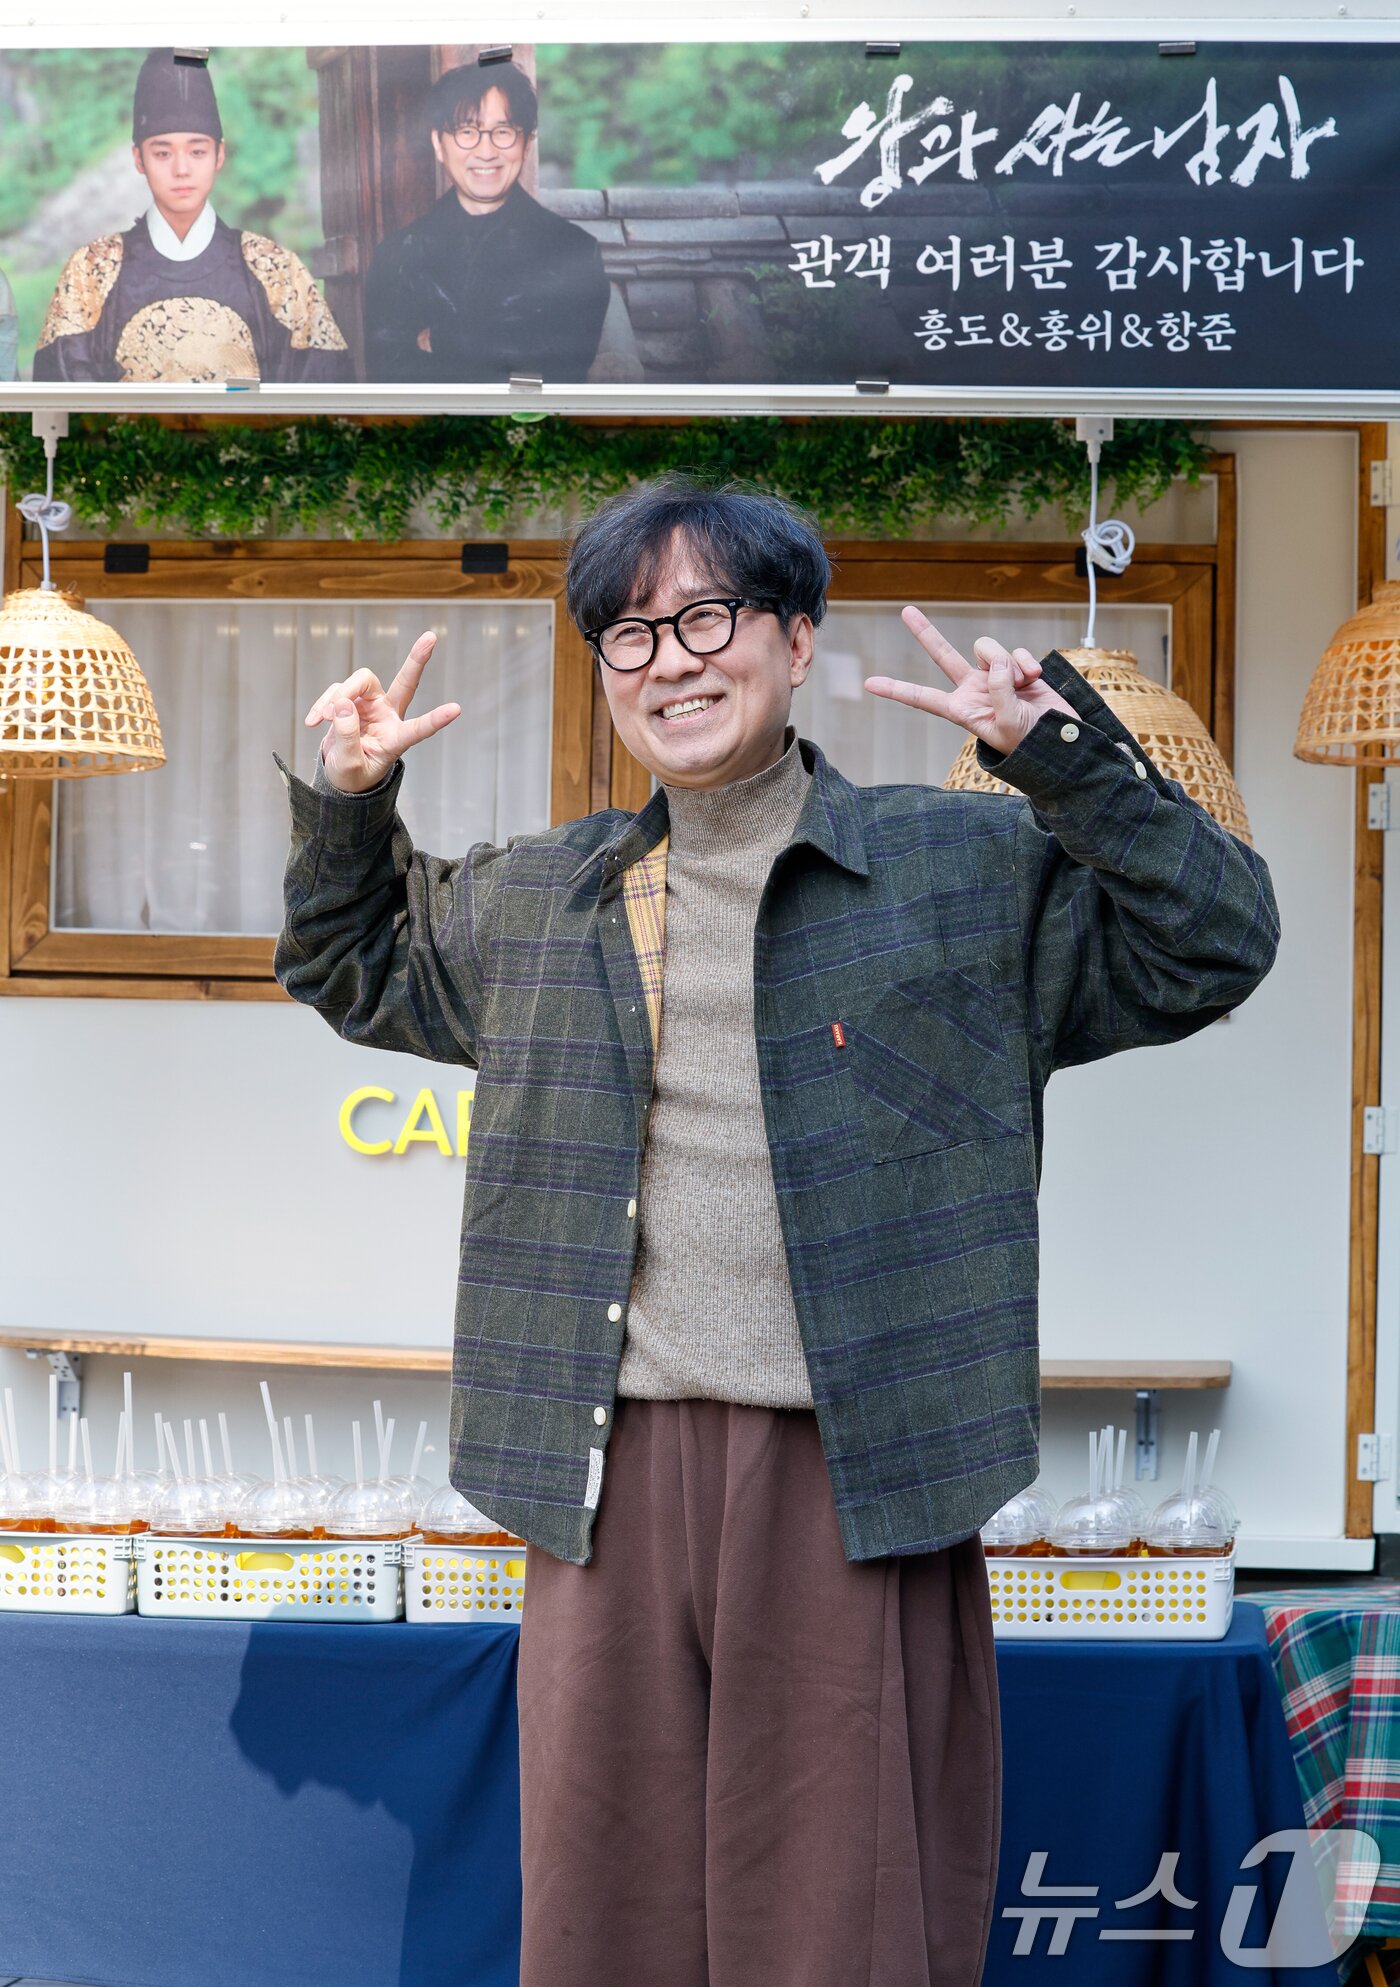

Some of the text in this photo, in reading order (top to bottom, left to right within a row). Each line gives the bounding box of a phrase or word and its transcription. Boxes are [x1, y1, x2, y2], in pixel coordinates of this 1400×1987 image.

[813, 73, 1339, 210] 왕과 사는 남자
[788, 234, 1364, 294] 관객 여러분 감사합니다
[913, 308, 1237, 353] 흥도&홍위&항준
